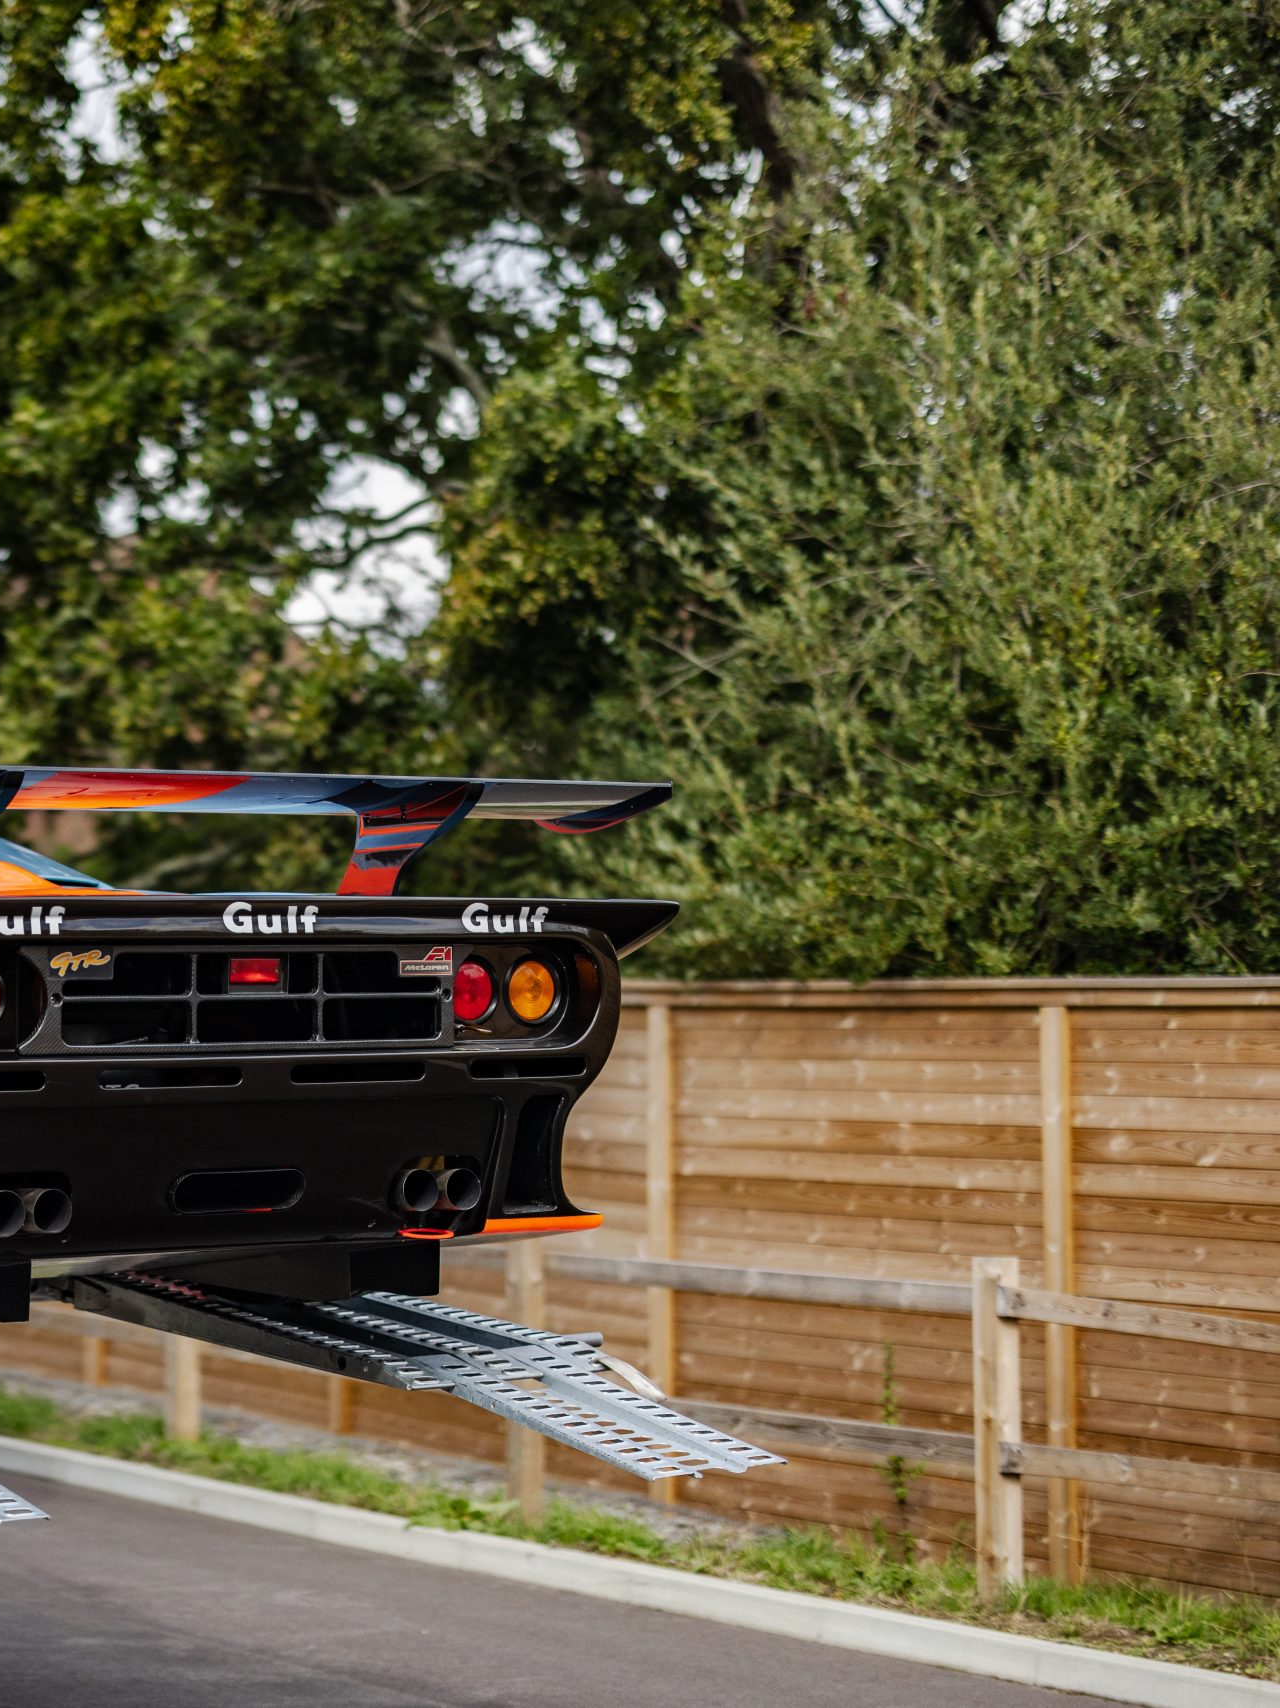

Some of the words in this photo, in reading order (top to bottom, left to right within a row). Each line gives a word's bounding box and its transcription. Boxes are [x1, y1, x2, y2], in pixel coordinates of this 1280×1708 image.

[222, 901, 319, 934] Gulf
[461, 902, 549, 933] Gulf
[50, 949, 111, 977] GTR
[404, 963, 449, 972] McLaren
